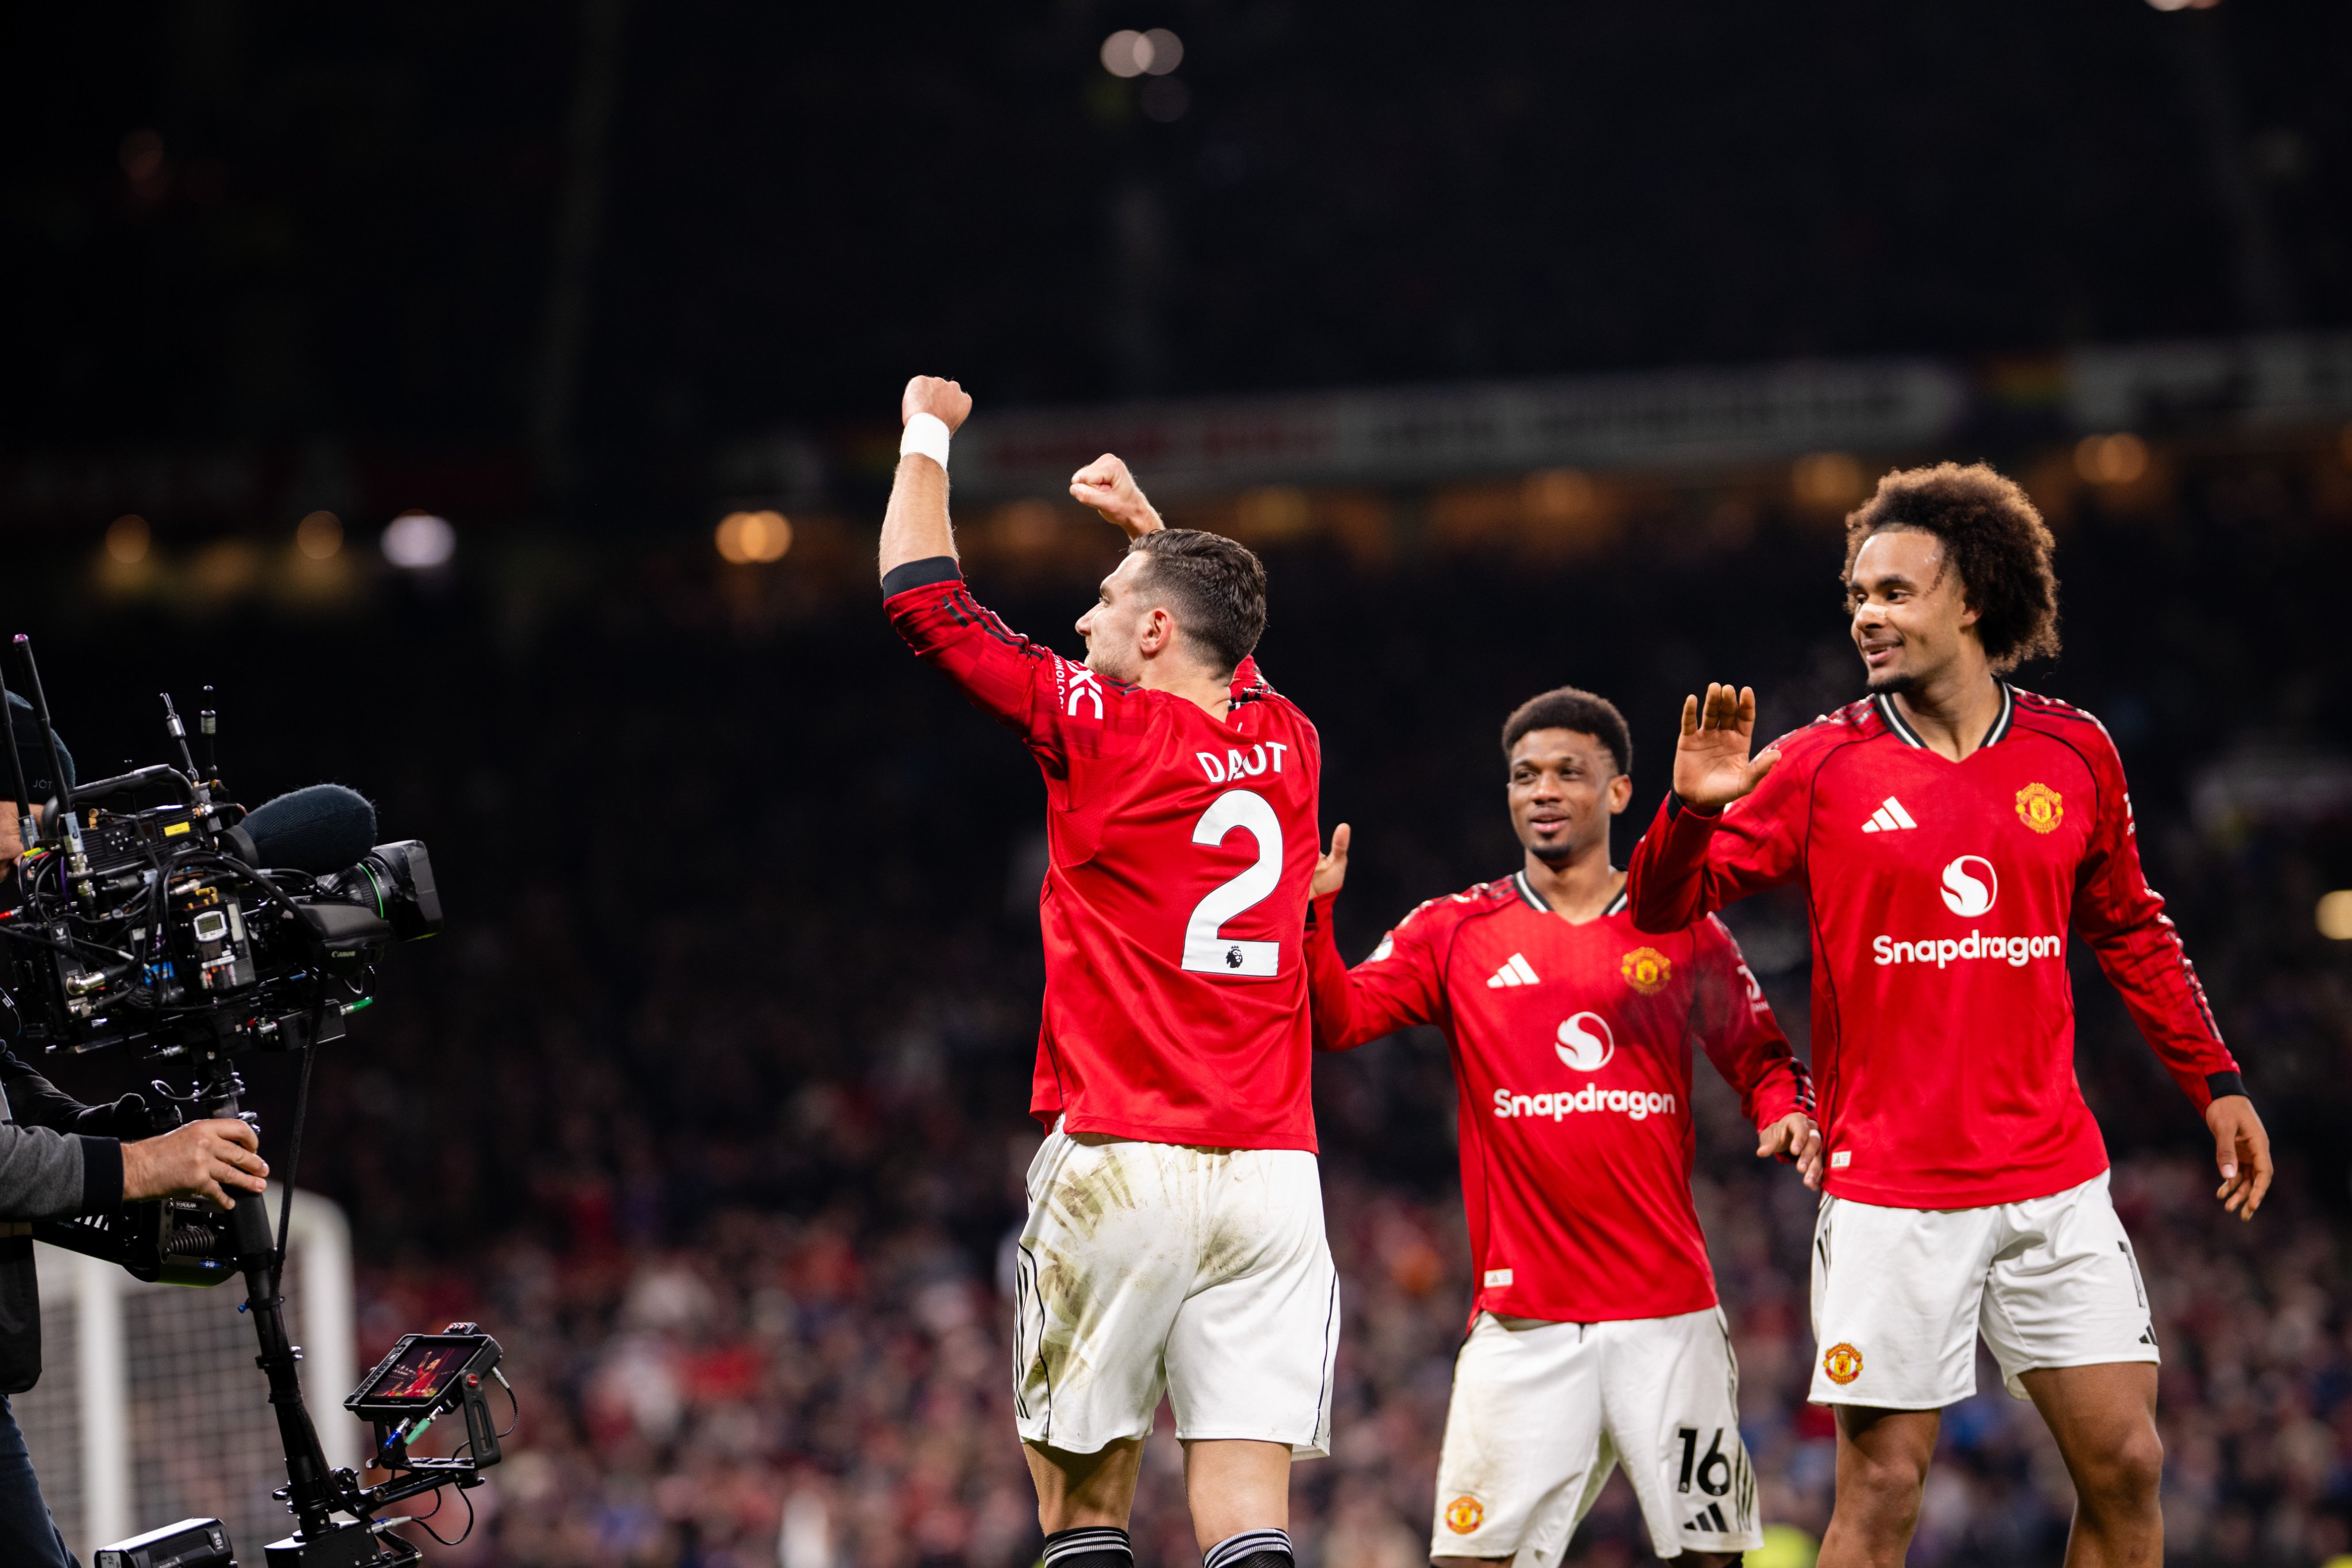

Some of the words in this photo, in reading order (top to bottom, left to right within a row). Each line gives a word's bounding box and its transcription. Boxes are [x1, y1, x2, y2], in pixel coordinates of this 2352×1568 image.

[2021, 785, 2060, 803] MANCHESTER
[2028, 819, 2056, 830] UNITED
[1180, 788, 1284, 978] 2
[1873, 929, 2061, 969] Snapdragon
[1494, 1082, 1676, 1122] Snapdragon
[1678, 1427, 1731, 1496] 16
